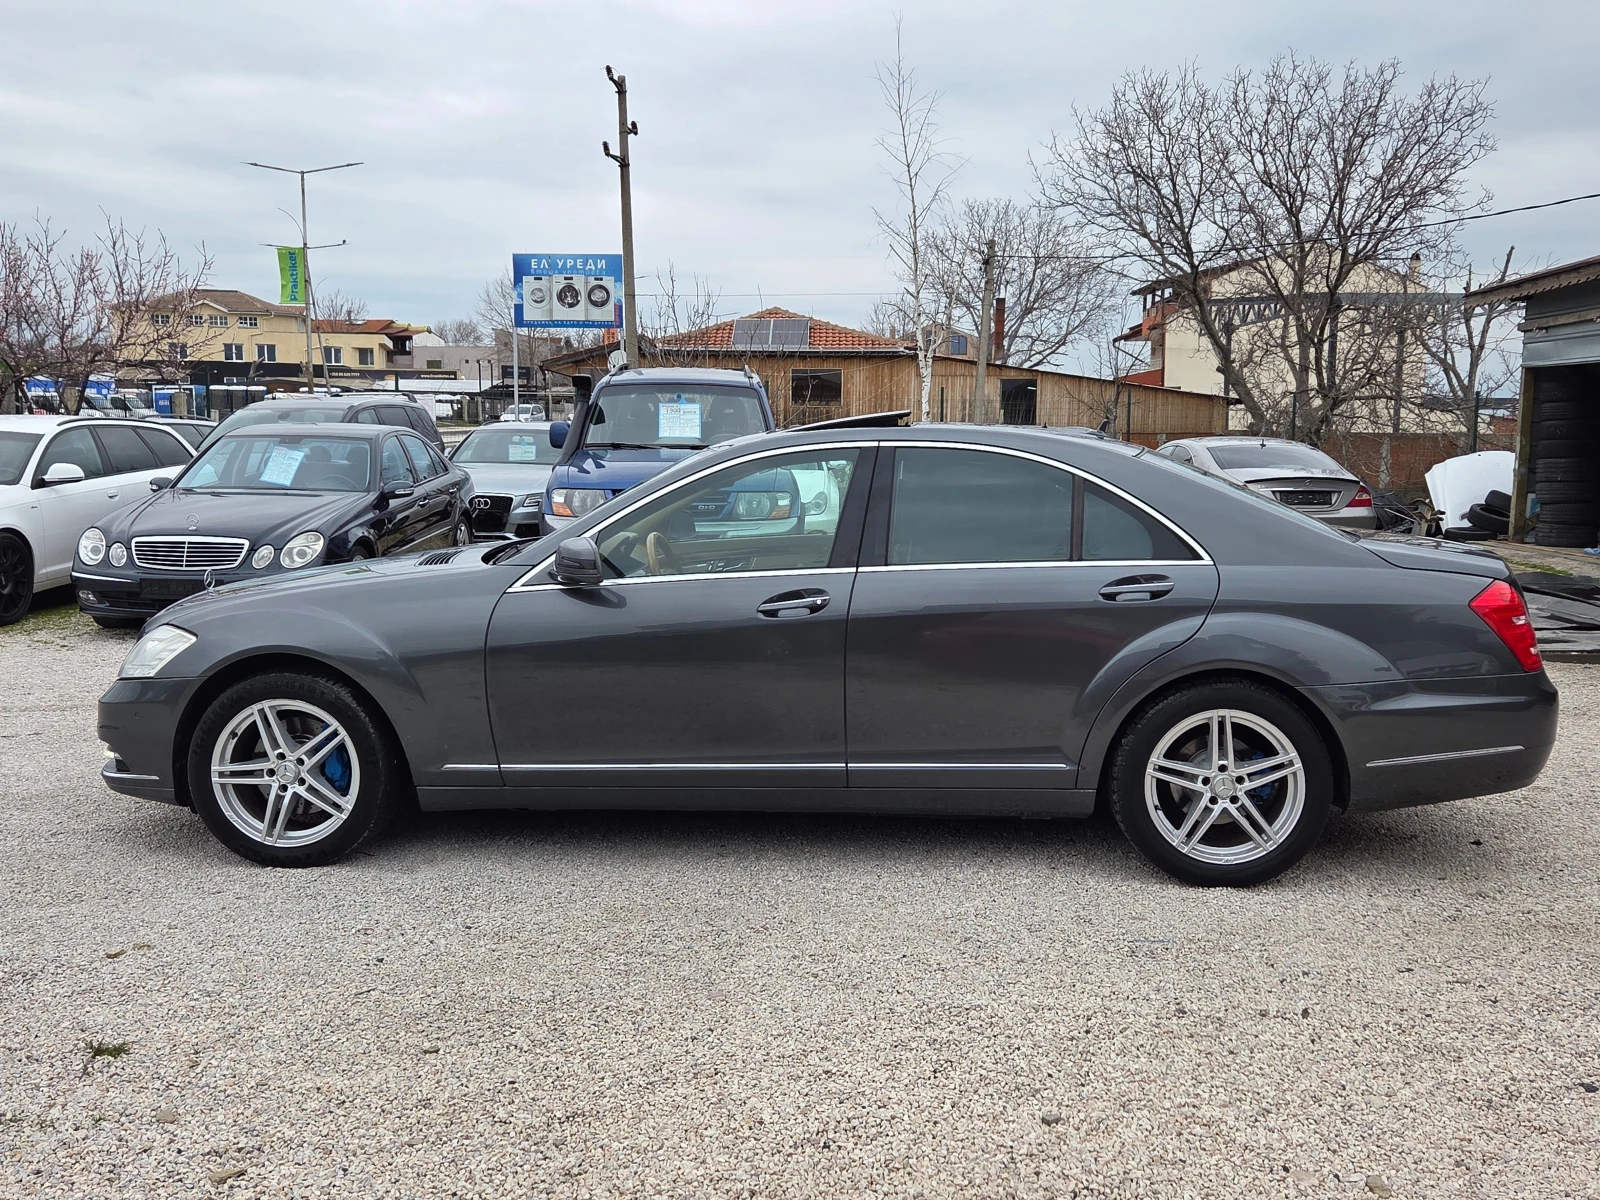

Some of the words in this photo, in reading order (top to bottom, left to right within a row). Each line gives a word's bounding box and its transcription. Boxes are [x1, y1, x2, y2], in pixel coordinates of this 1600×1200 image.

[289, 251, 298, 301] Praktiker
[531, 259, 549, 269] ЕЛ
[556, 259, 606, 271] УРЕДИ
